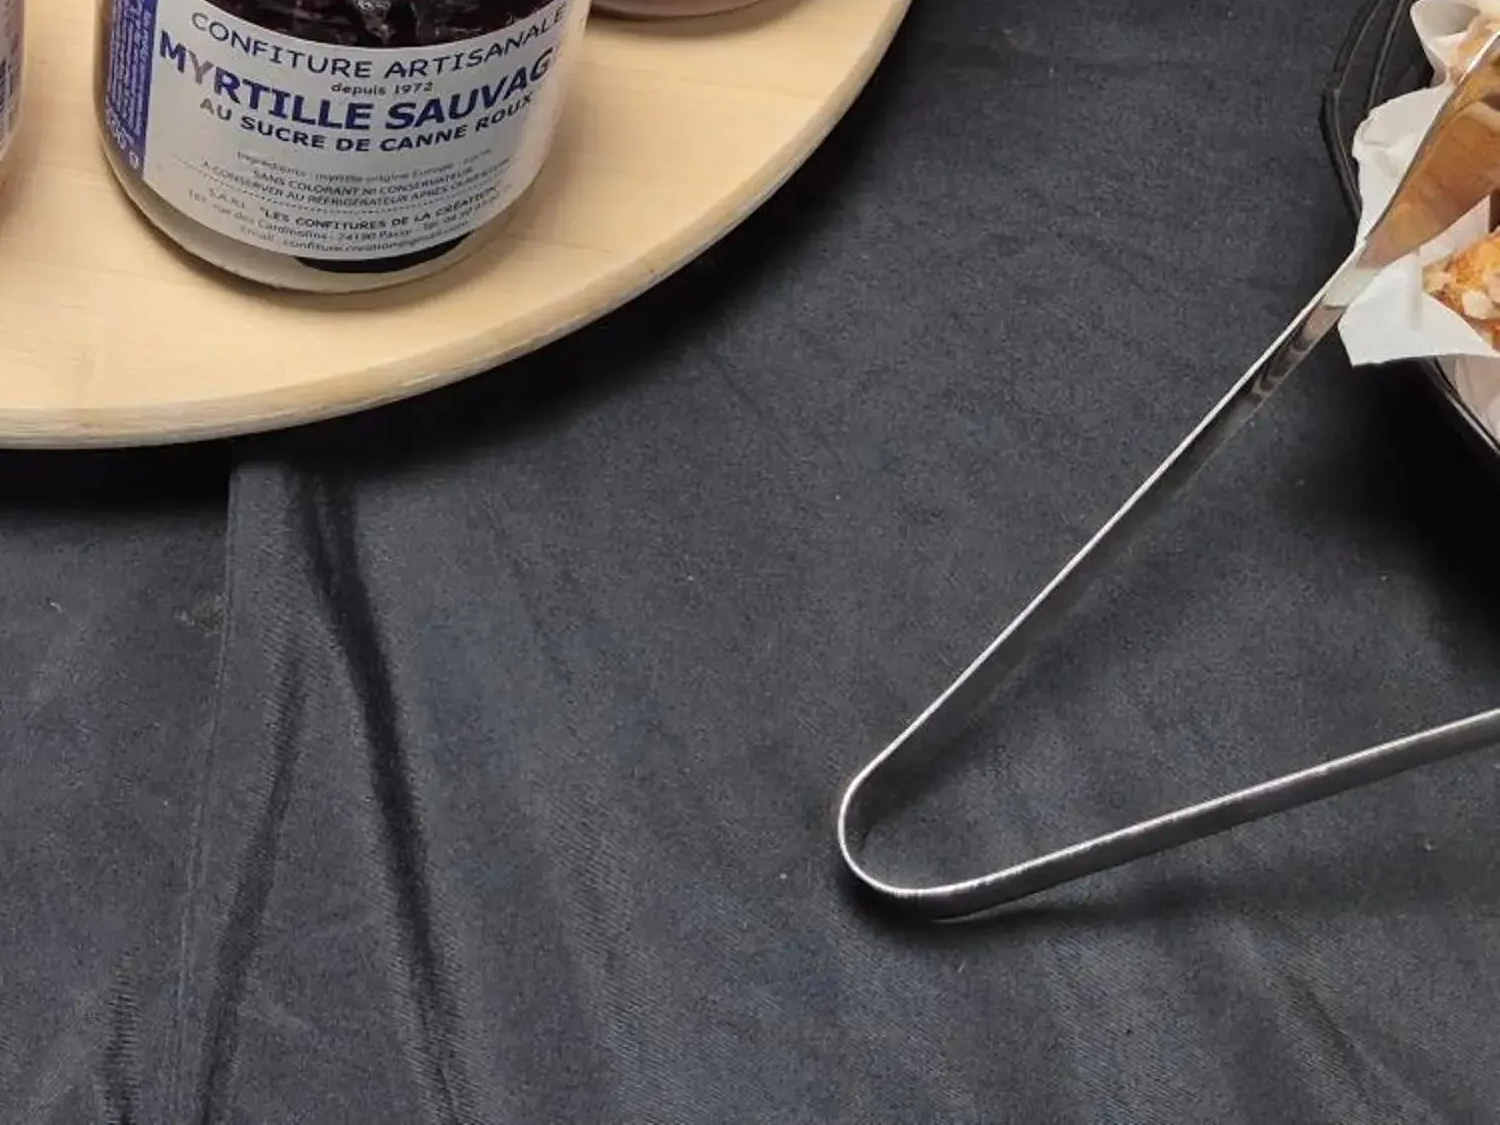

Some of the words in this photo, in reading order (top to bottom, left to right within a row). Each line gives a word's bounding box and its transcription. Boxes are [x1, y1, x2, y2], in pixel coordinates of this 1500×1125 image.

[191, 11, 374, 79] CONFITURE
[384, 2, 567, 79] ARTISANALE
[159, 29, 375, 131] MYRTILLE
[330, 82, 387, 97] depuis
[394, 81, 434, 95] 1972
[200, 98, 233, 122] AU
[240, 116, 328, 149] SUCRE
[336, 138, 371, 153] DE
[379, 124, 468, 153] CANNE
[475, 90, 534, 132] ROUX
[288, 179, 360, 196] COLORANT
[295, 217, 387, 231] CONFITURES
[391, 216, 409, 227] DE
[414, 212, 432, 223] LA
